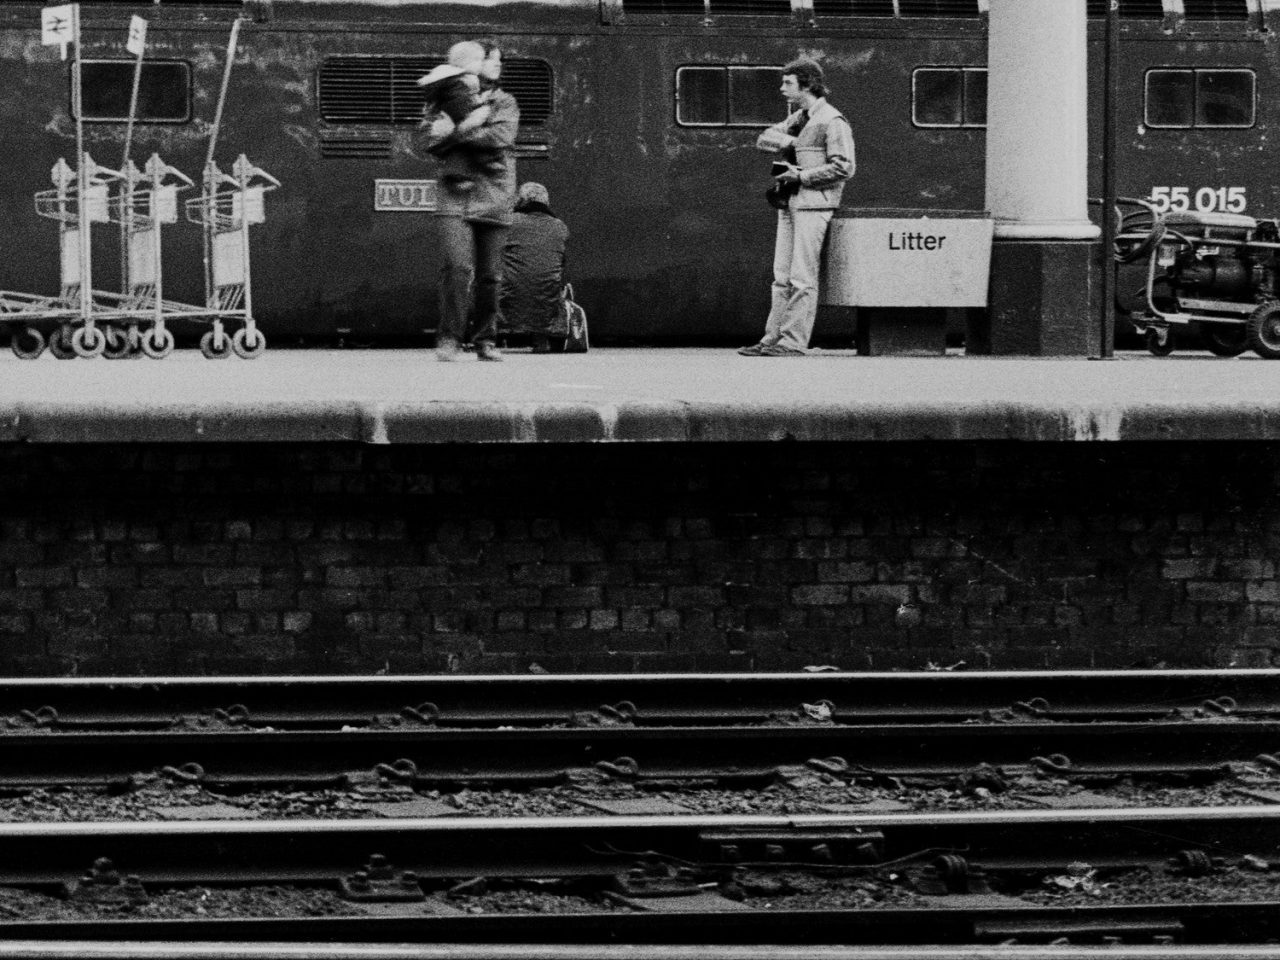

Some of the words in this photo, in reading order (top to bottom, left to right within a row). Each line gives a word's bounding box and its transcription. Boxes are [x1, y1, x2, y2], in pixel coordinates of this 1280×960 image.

[379, 185, 437, 206] TUL
[1151, 186, 1190, 212] 55
[1195, 186, 1246, 213] 015
[888, 232, 947, 251] Litter
